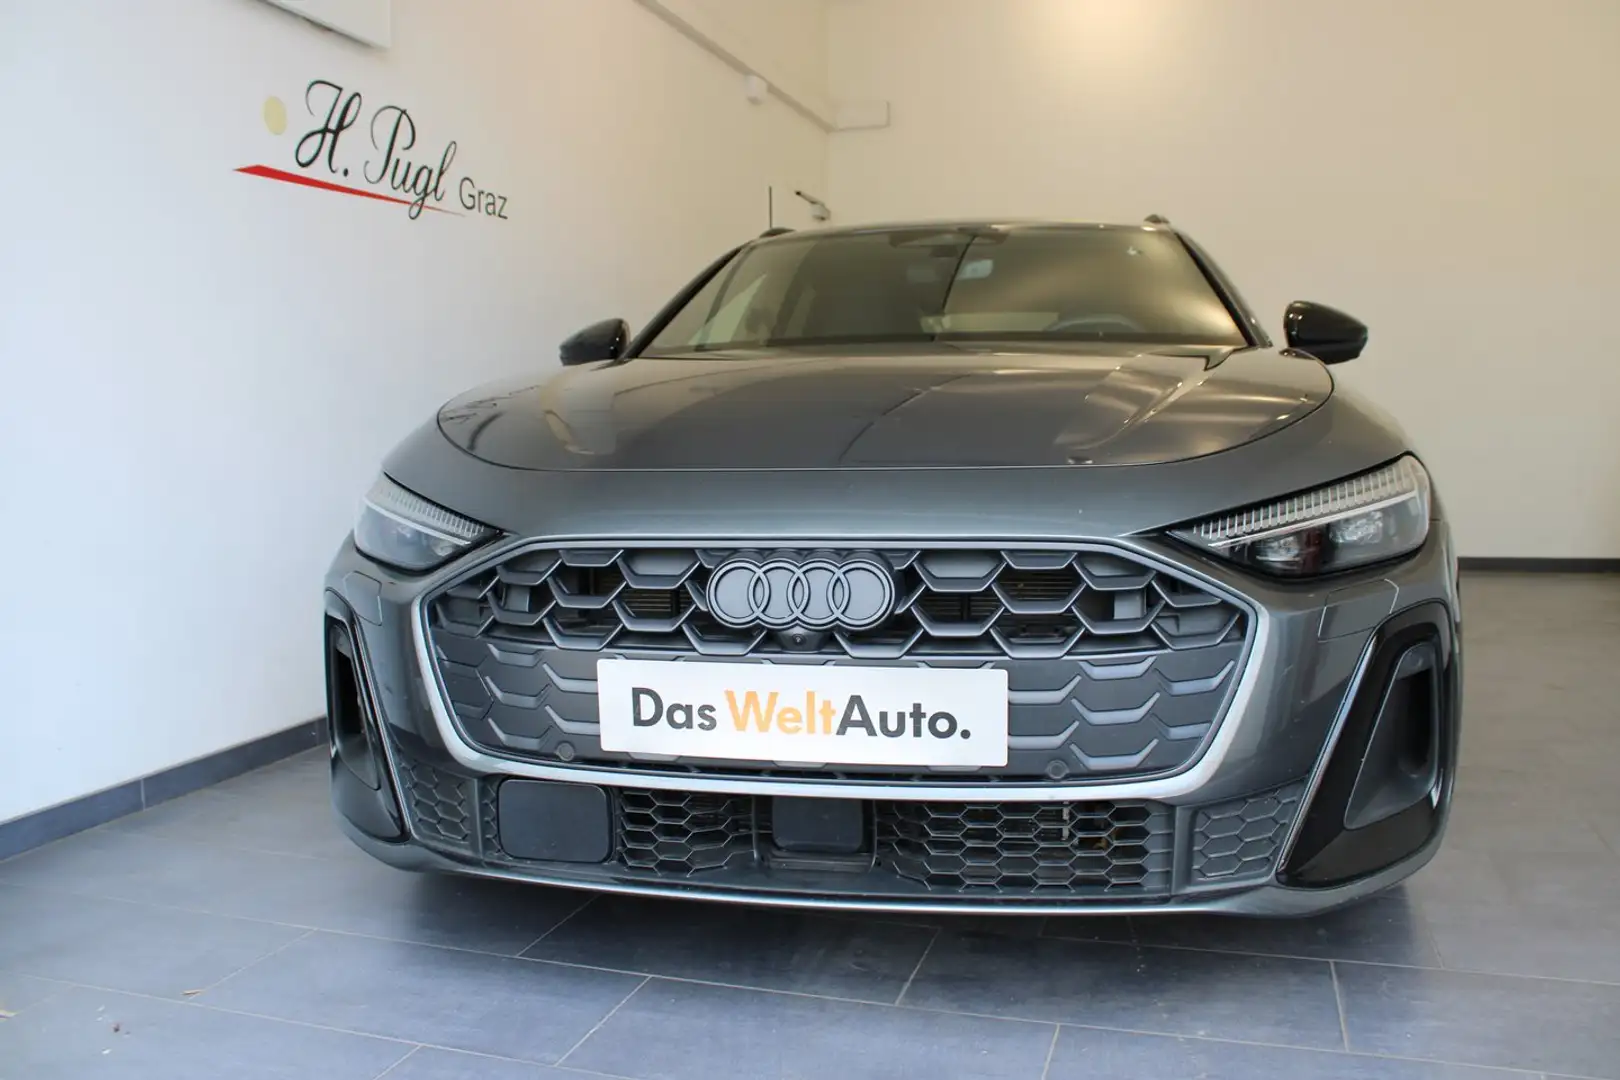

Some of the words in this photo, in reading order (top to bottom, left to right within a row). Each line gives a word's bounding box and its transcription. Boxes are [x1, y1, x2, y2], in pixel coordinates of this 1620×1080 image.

[295, 79, 362, 177] H.
[363, 105, 457, 220] Pugl
[459, 177, 508, 219] Graz
[631, 687, 717, 731] Das
